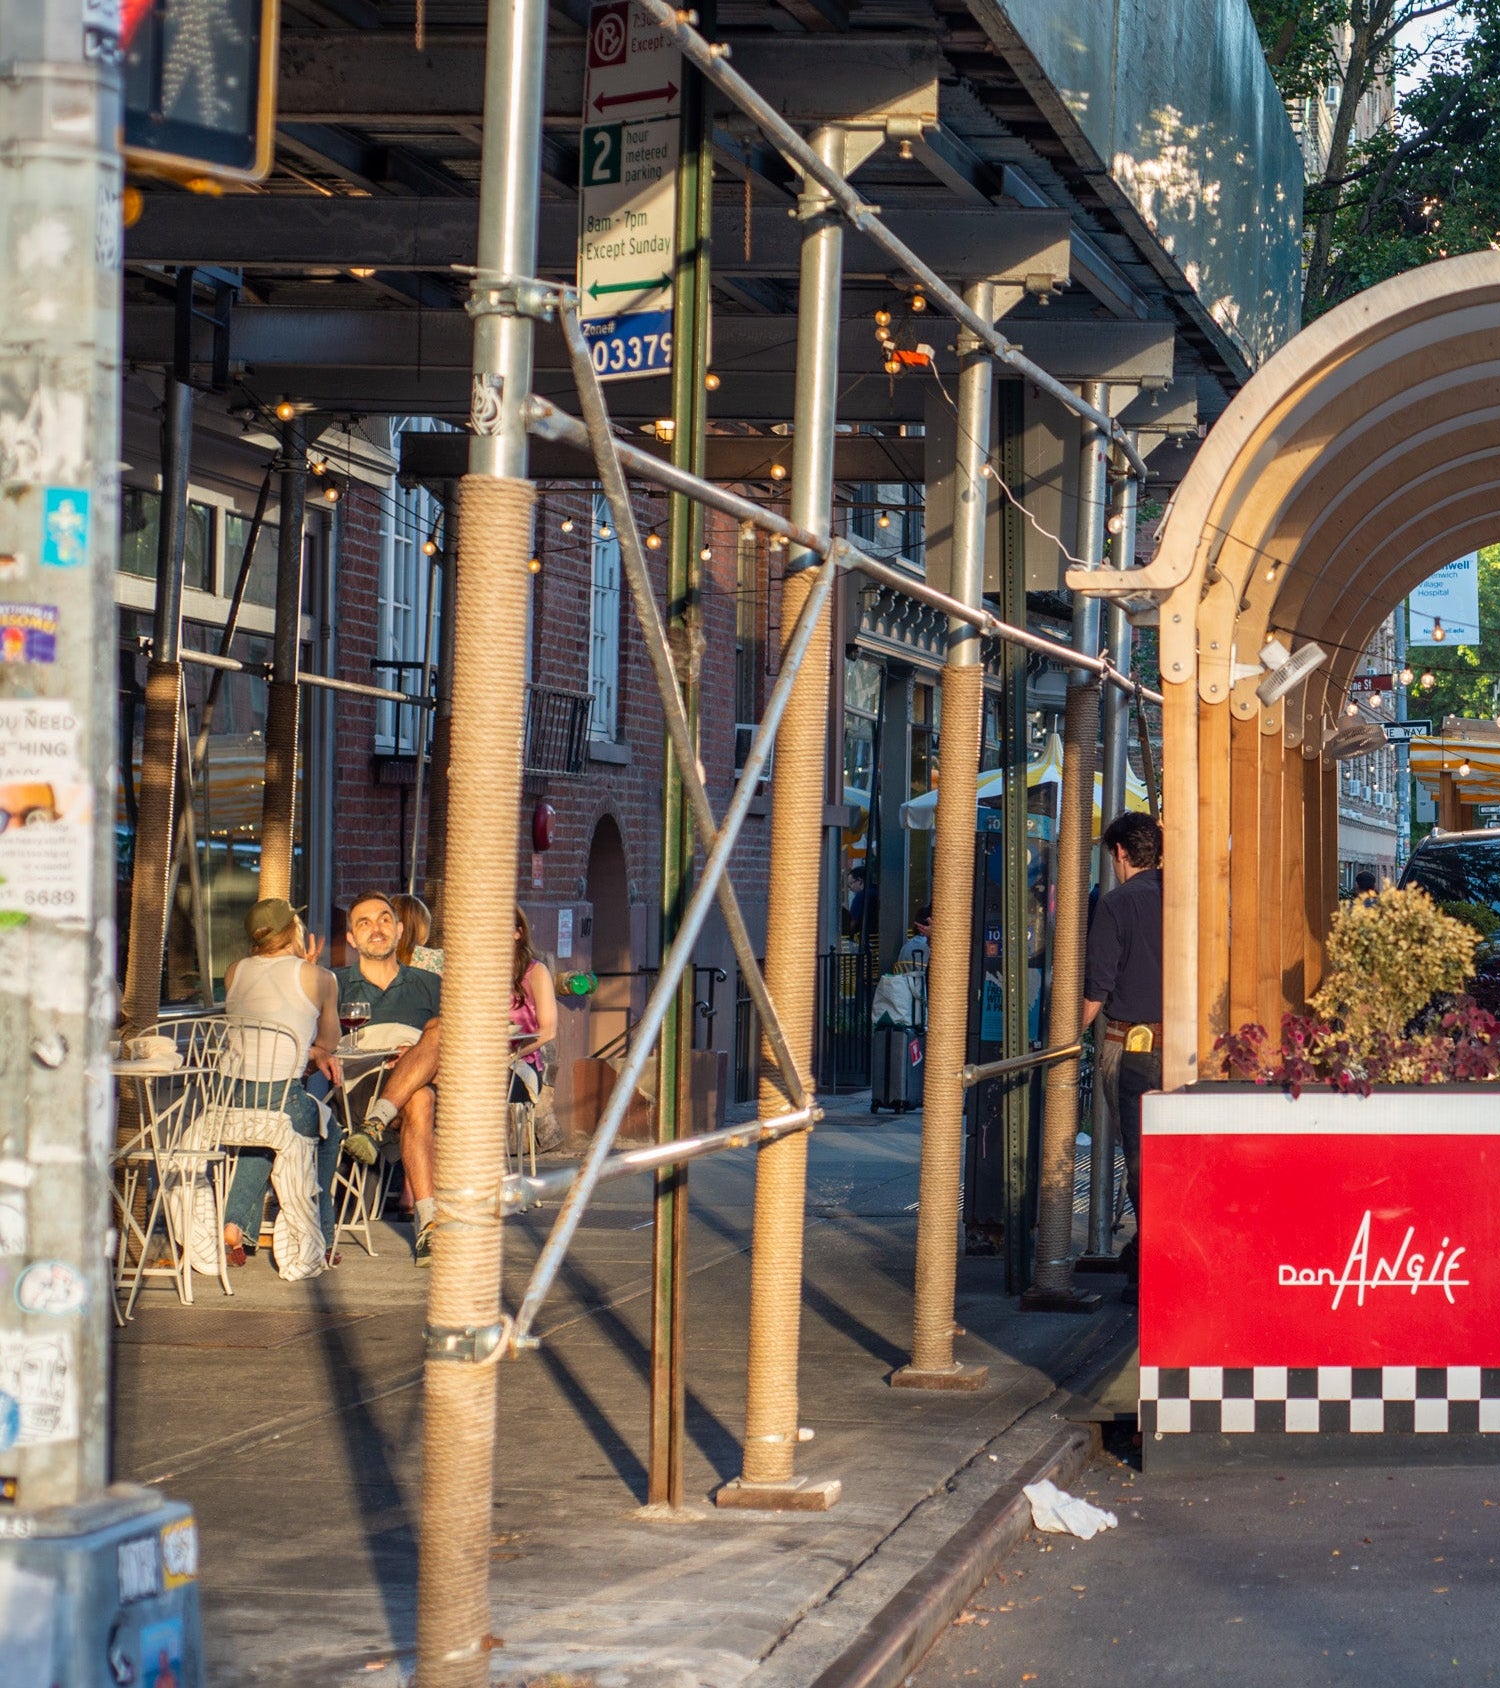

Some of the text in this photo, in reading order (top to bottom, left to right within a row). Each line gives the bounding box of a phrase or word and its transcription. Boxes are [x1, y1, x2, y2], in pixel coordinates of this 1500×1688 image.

[631, 32, 664, 53] Except
[592, 130, 649, 181] 2 hour
[625, 144, 668, 164] metered
[625, 165, 662, 187] parking
[586, 215, 612, 233] 8am
[624, 210, 648, 232] 7pm
[586, 235, 671, 262] Except Sunday
[583, 321, 616, 337] Zone#
[1417, 588, 1450, 598] Hospital
[1364, 678, 1372, 690] St
[25, 714, 76, 731] NEED
[1403, 727, 1423, 737] WAY
